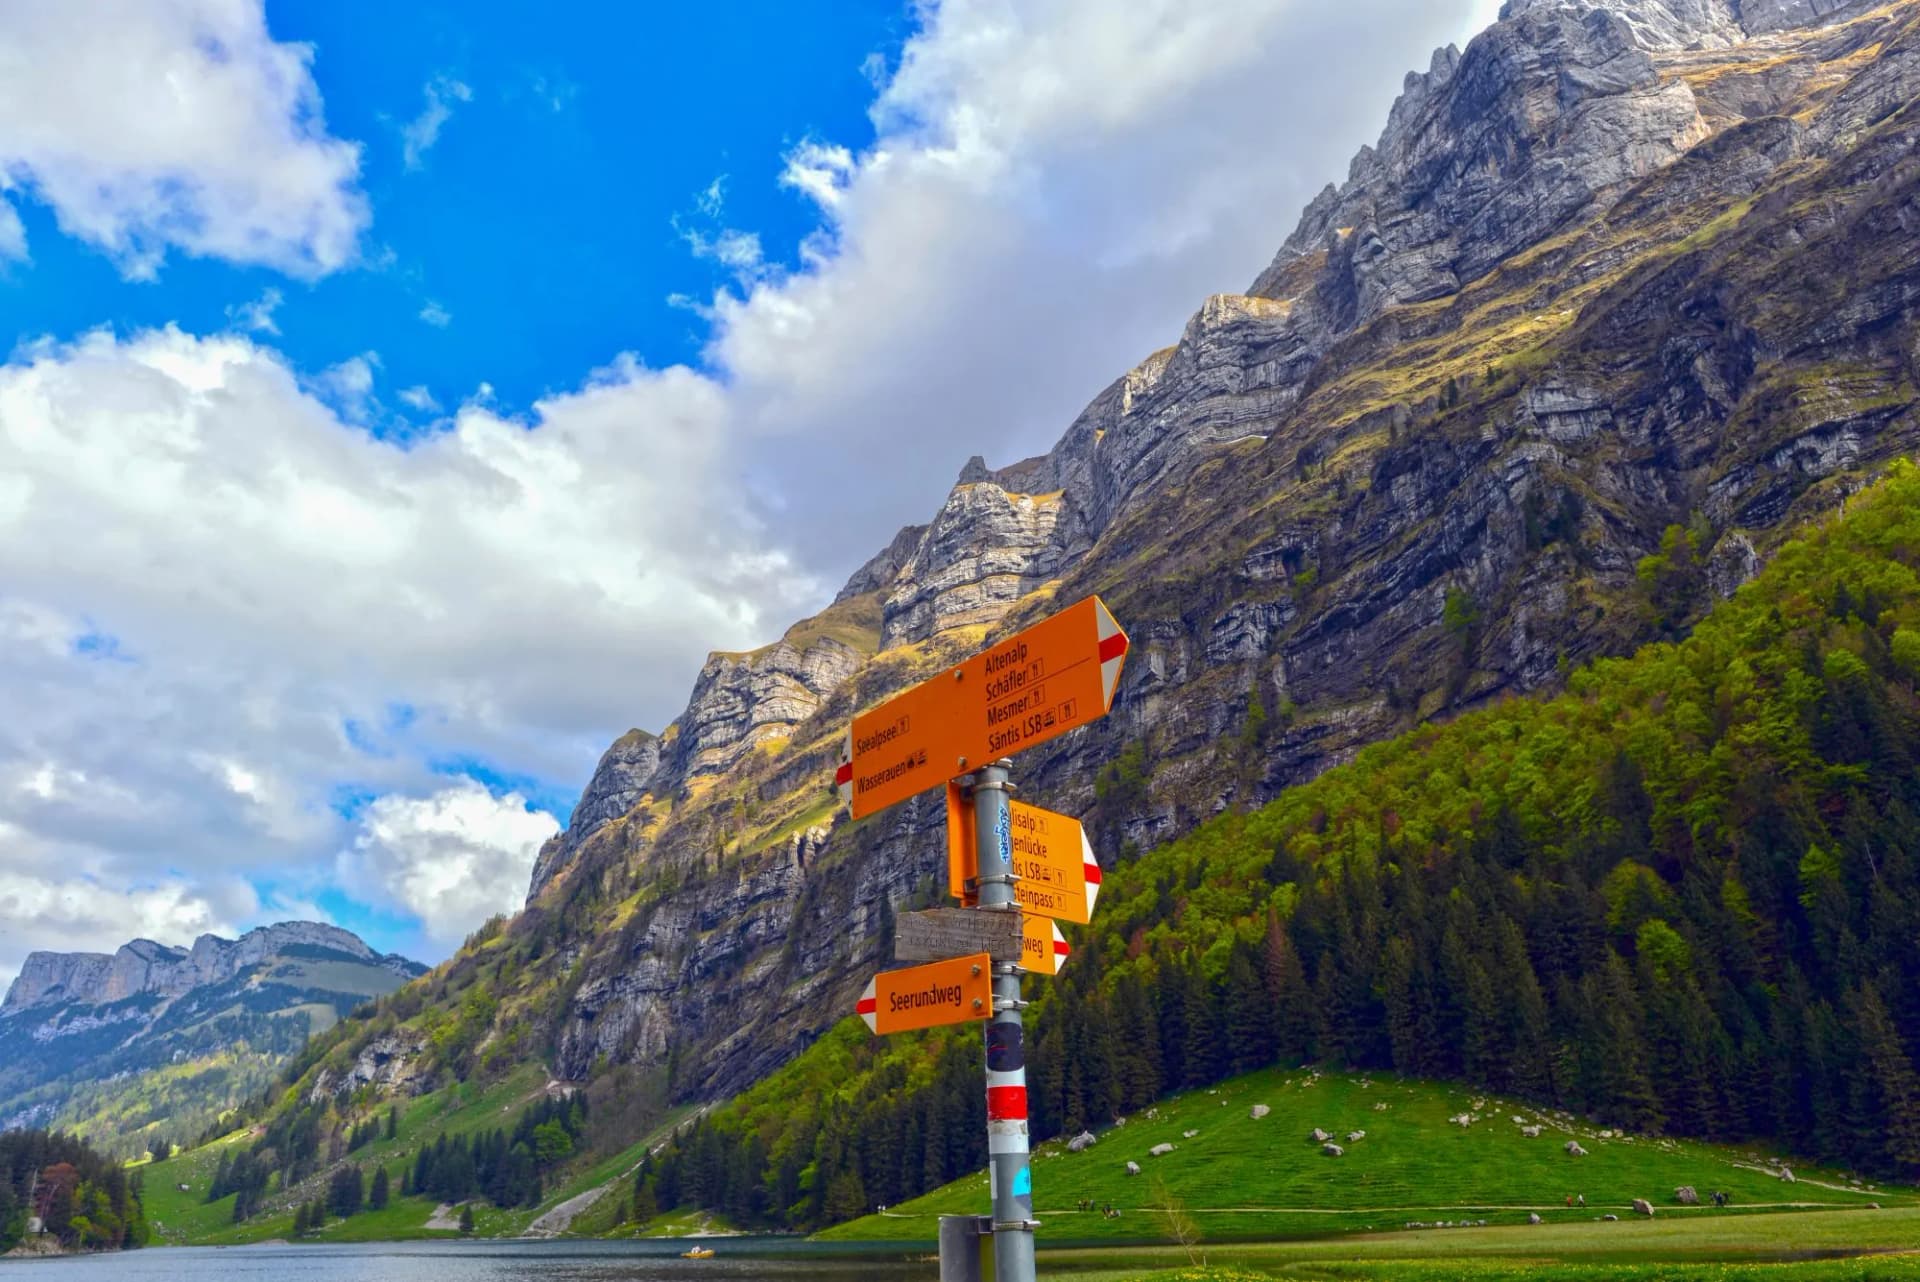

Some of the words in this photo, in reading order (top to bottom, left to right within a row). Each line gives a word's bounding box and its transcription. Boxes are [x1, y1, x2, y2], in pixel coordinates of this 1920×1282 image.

[985, 641, 1028, 676] Altenalp
[986, 667, 1027, 702] Schäfler
[987, 696, 1028, 727] Mesmer
[856, 725, 897, 757] Seealpsee
[988, 725, 1020, 754] Säntis
[1023, 713, 1042, 739] LSB
[857, 761, 907, 794] Wasserauen
[1010, 807, 1036, 836] lisalp
[1011, 835, 1047, 859] enlücke
[1024, 861, 1041, 881] LSB
[1014, 885, 1054, 910] teinpass
[890, 984, 962, 1013] Seerundweg
